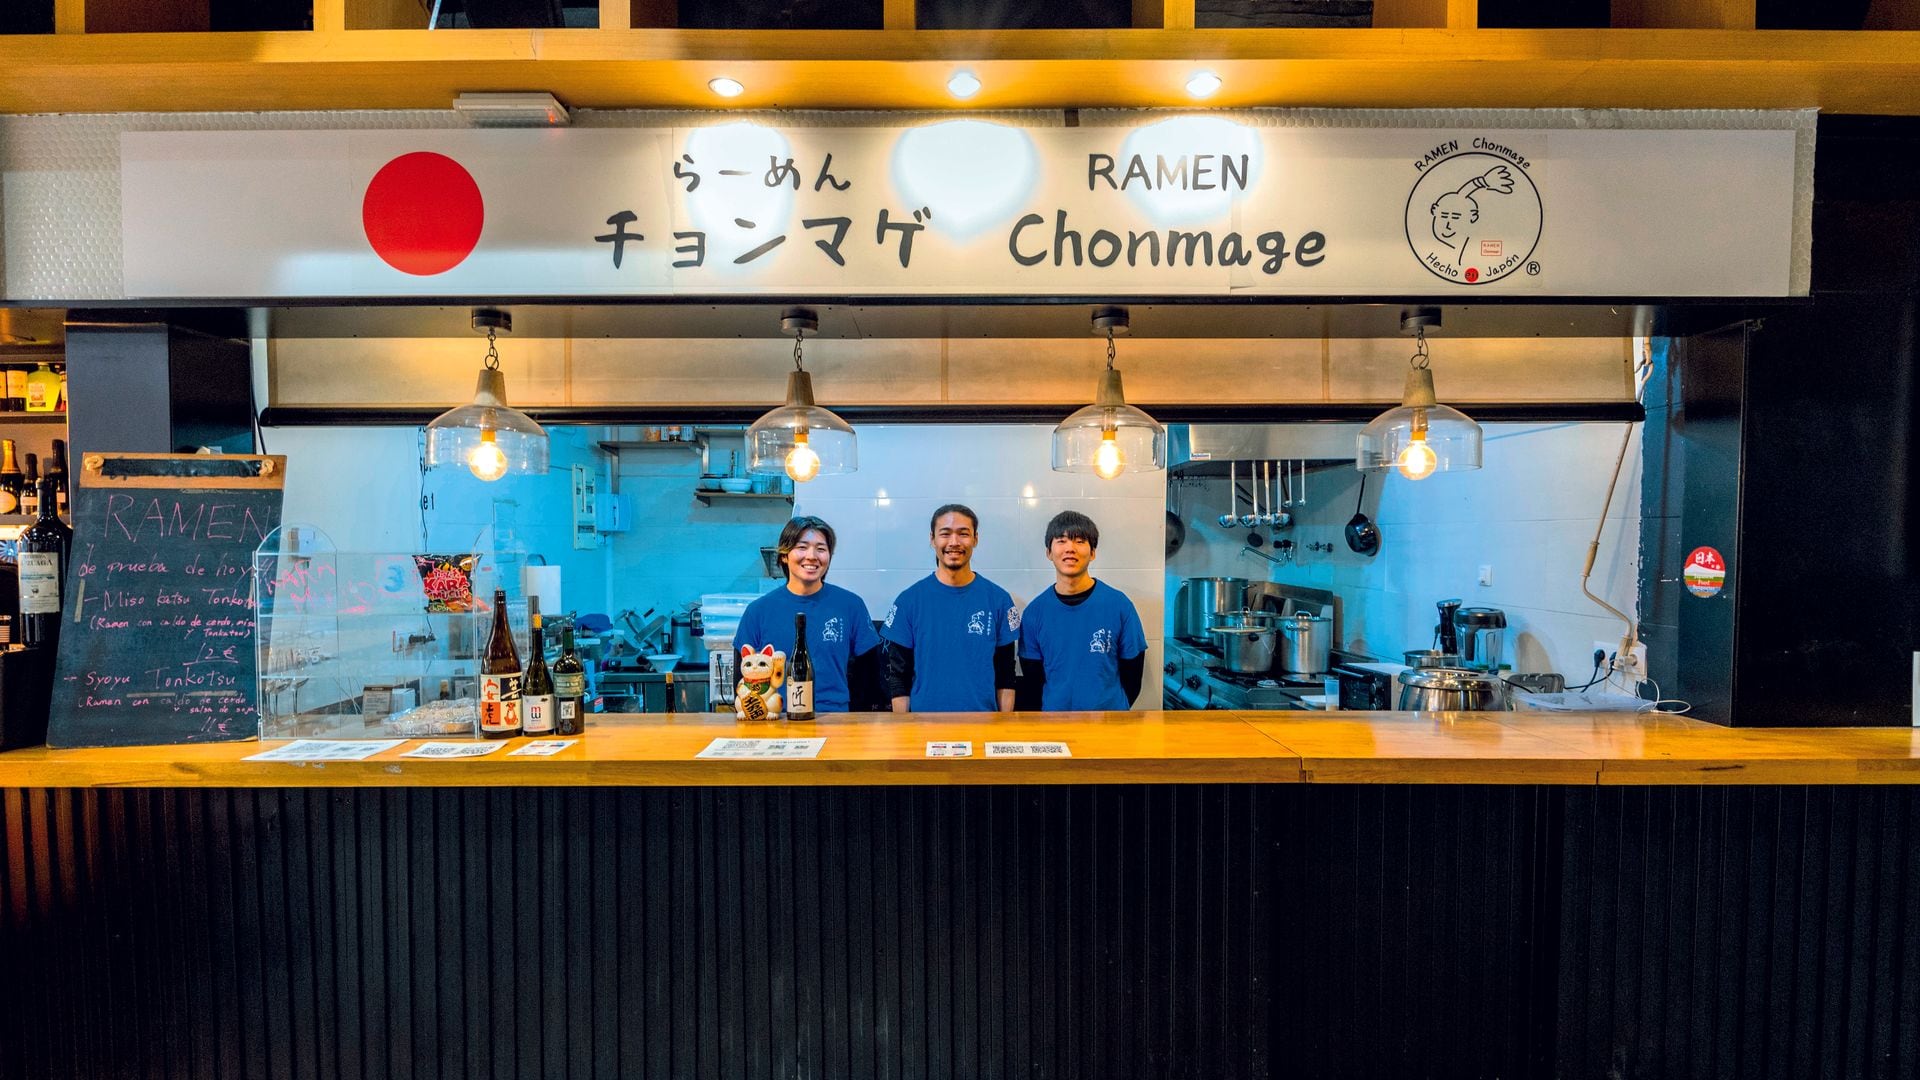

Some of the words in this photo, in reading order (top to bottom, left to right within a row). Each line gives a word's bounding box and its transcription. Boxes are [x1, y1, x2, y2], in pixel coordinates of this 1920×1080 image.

[1414, 140, 1459, 172] RAMEN
[1472, 137, 1531, 169] Chonmage
[673, 153, 852, 192] らーめん
[1088, 153, 1249, 191] RAMEN
[594, 206, 932, 270] チョンマゲ
[1009, 209, 1326, 275] Chonmage
[1425, 252, 1458, 278] Hecho
[1465, 271, 1479, 279] en
[1486, 253, 1520, 277] Japón
[104, 494, 271, 544] RAMEN
[78, 543, 97, 577] de
[107, 552, 169, 581] prueba
[185, 553, 205, 575] de
[1695, 551, 1716, 565] 日本
[423, 575, 470, 592] KARA
[431, 588, 468, 600] MUCHO
[104, 590, 145, 611] Miso
[137, 619, 152, 627] con
[190, 614, 202, 628] de
[85, 671, 131, 691] Syoyu
[145, 666, 236, 690] Tonkotsu
[132, 698, 150, 706] con
[218, 694, 246, 704] cerdo
[792, 685, 806, 708] 匠
